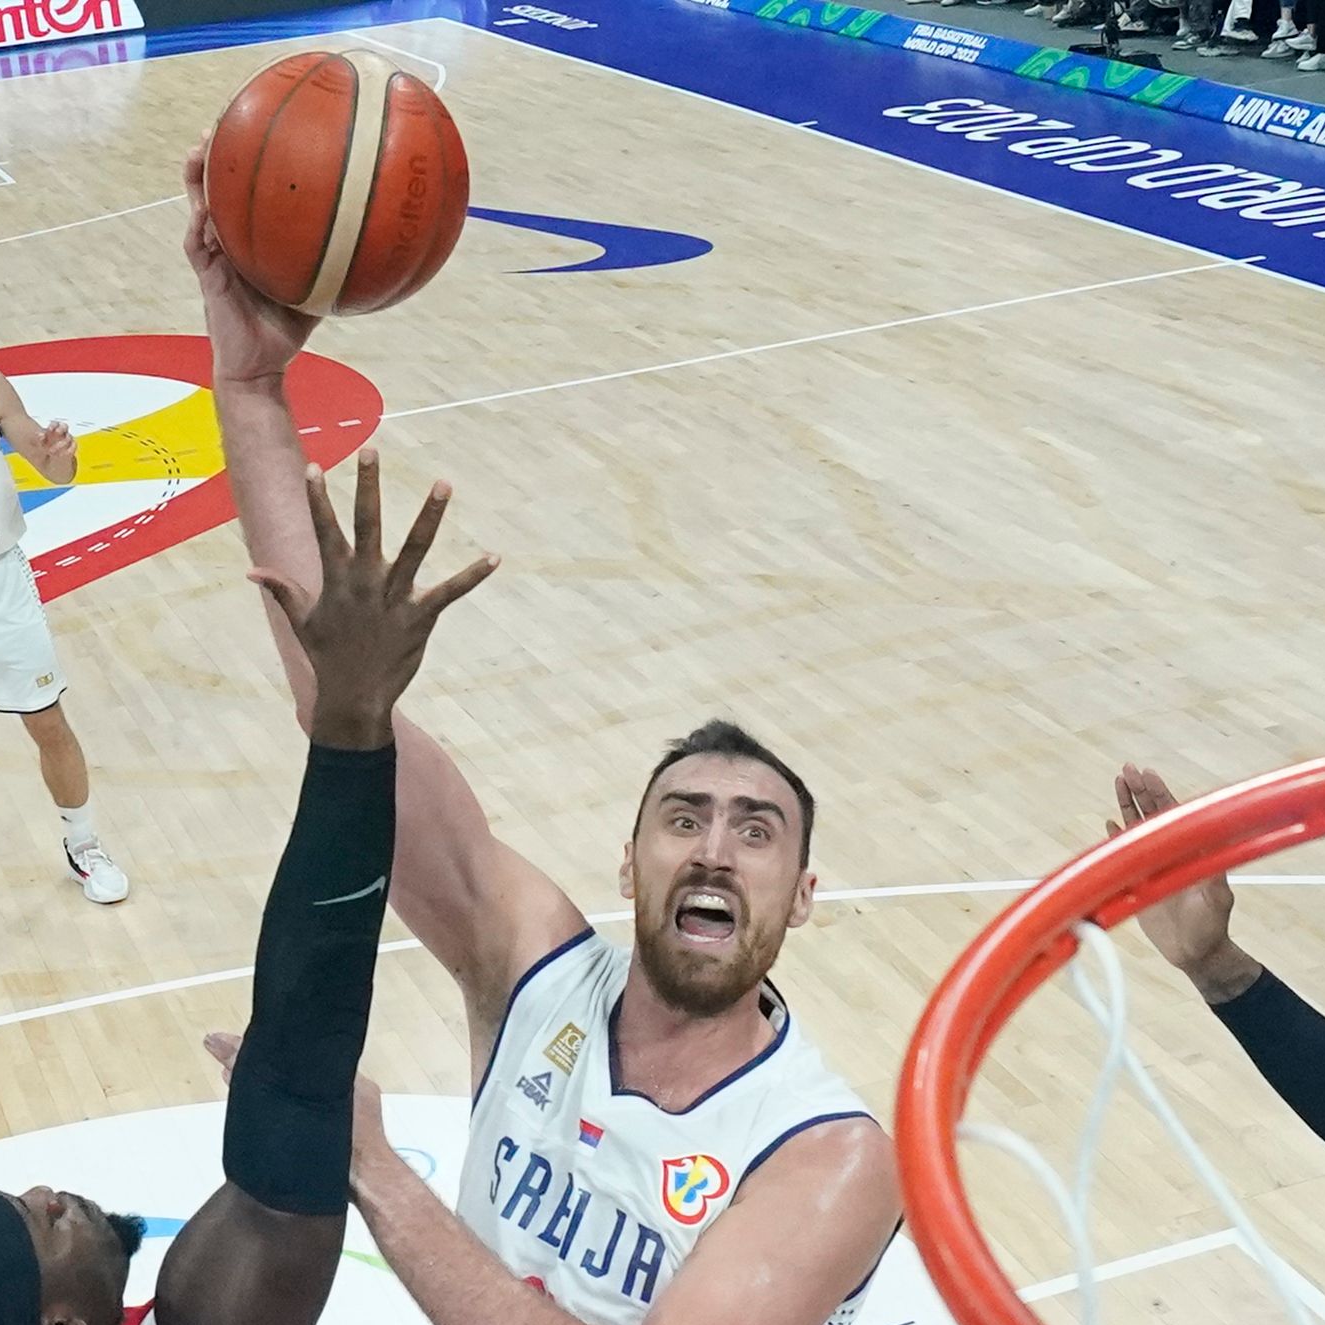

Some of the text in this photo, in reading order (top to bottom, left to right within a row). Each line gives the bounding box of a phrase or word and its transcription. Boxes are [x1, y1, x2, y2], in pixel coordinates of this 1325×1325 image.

[882, 98, 1076, 142] 2023
[1223, 94, 1280, 130] WIN
[1273, 104, 1311, 127] FOR
[1007, 135, 1183, 172] CUP
